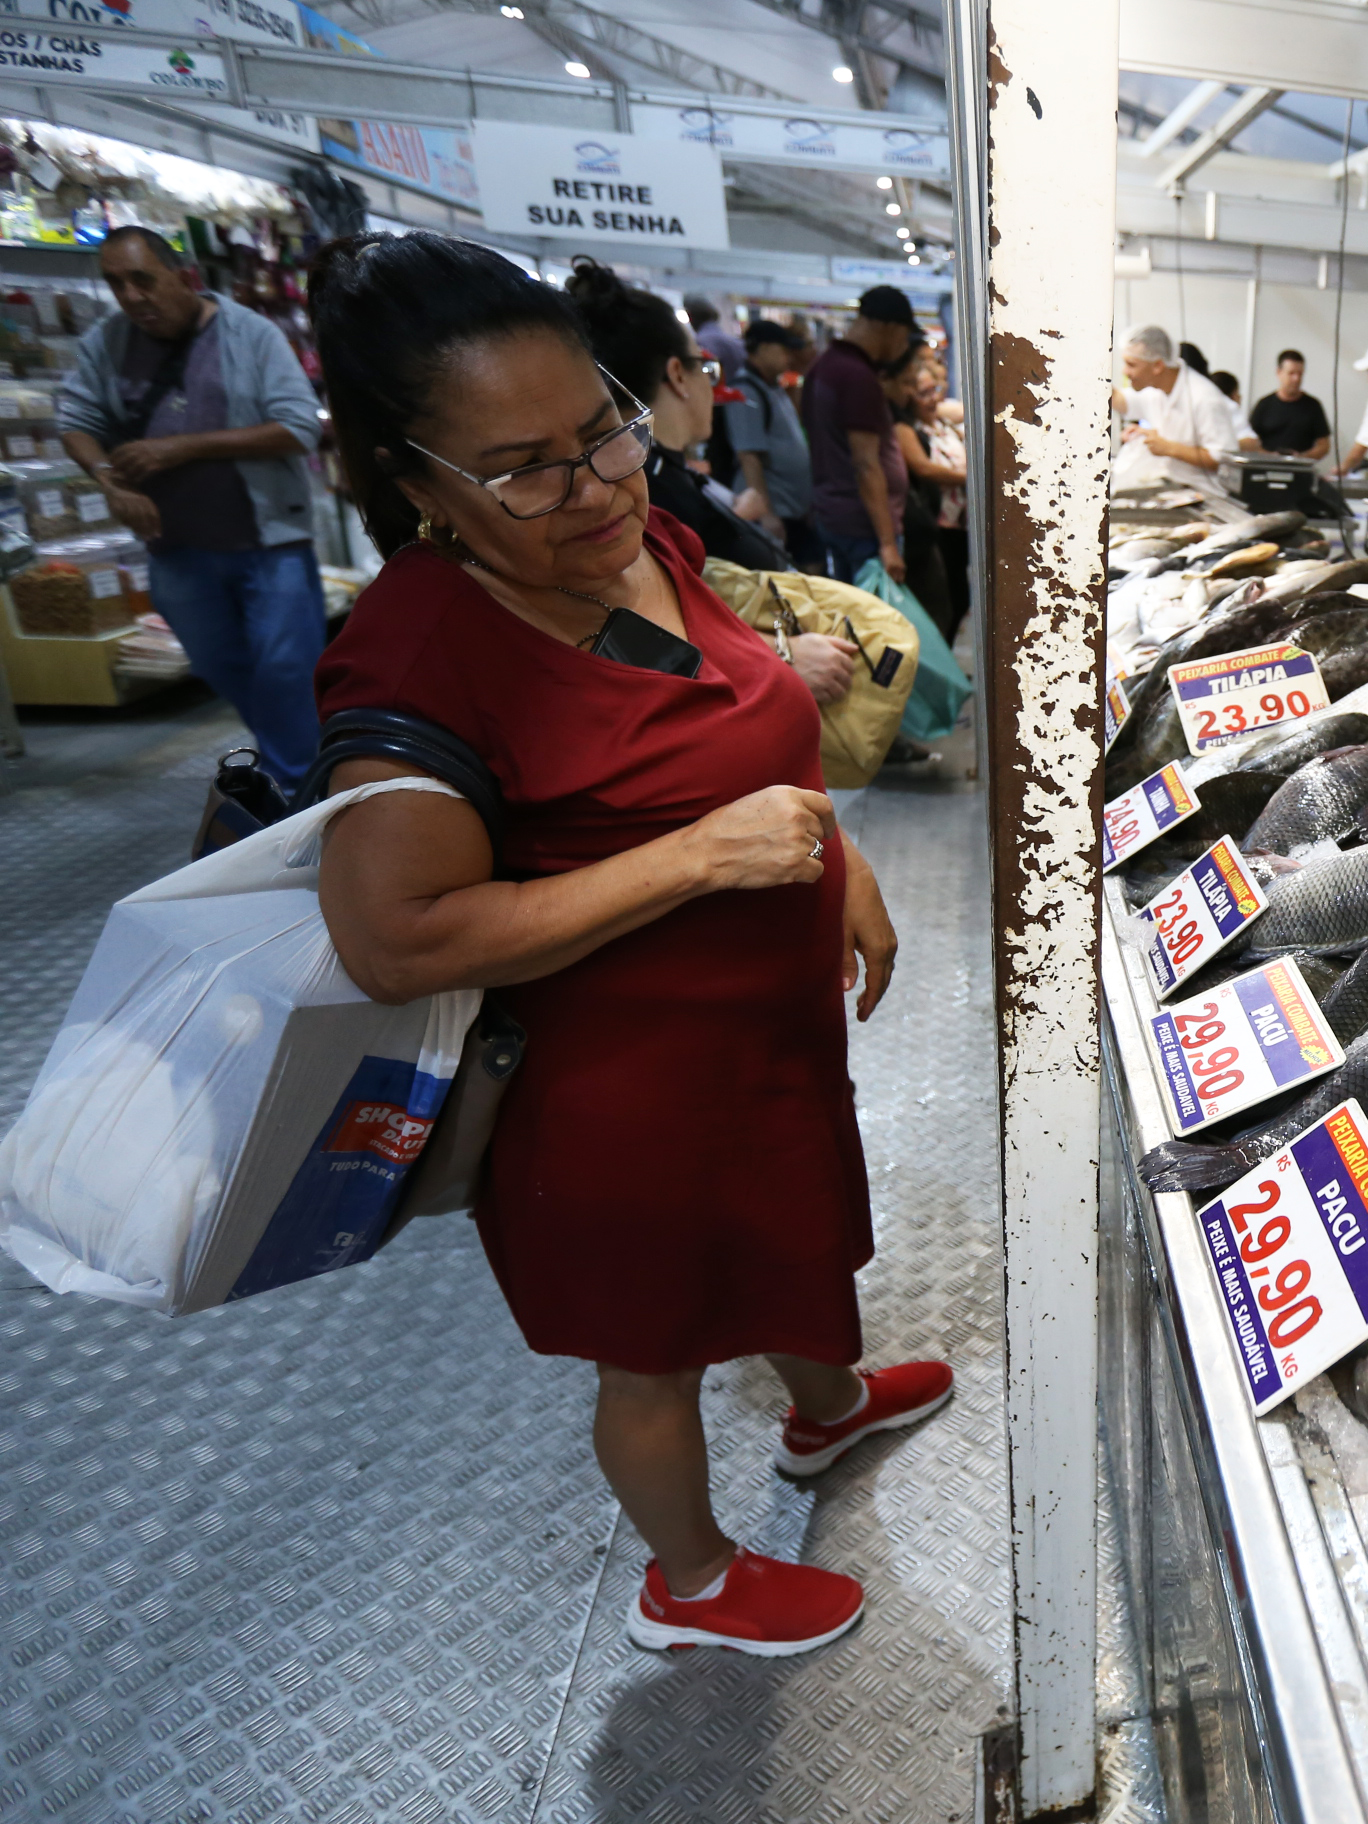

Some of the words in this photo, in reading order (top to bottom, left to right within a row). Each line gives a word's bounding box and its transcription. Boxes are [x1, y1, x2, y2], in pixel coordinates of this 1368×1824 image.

[150, 71, 225, 92] COLOMBO
[553, 178, 653, 205] RETIRE
[527, 205, 584, 228] SUA
[592, 210, 686, 235] SENHA
[1178, 663, 1228, 681] PEIXARIA
[1230, 650, 1280, 671] COMBATE
[1208, 664, 1288, 695] TILÁPIA
[1193, 690, 1311, 739] 23,90
[1104, 798, 1140, 851] 24,90
[1212, 844, 1234, 874] PEIXARIA
[1226, 870, 1250, 901] COMBATE
[1199, 867, 1233, 924] TILÁPIA
[1153, 889, 1204, 965] 23,90
[1152, 950, 1170, 985] SAUDÁVEL
[1266, 966, 1298, 1006] PEIXARIA
[1285, 1003, 1319, 1045] COMBATE
[1157, 1022, 1174, 1046] PEIXE
[1174, 1002, 1244, 1100] 29,90
[1165, 1051, 1183, 1073] MAIS
[1205, 1101, 1219, 1116] KG
[381, 1128, 402, 1146] DA
[330, 1160, 361, 1172] TUDO
[361, 1160, 397, 1181] PARA
[1316, 1178, 1366, 1256] PACU
[1207, 1219, 1230, 1258] PEIXE
[1218, 1256, 1237, 1268] É
[1227, 1180, 1323, 1349] 29,90
[1280, 1353, 1299, 1379] KG
[1221, 1267, 1244, 1306] MAIS
[1233, 1304, 1269, 1385] SAUDÁVEL
